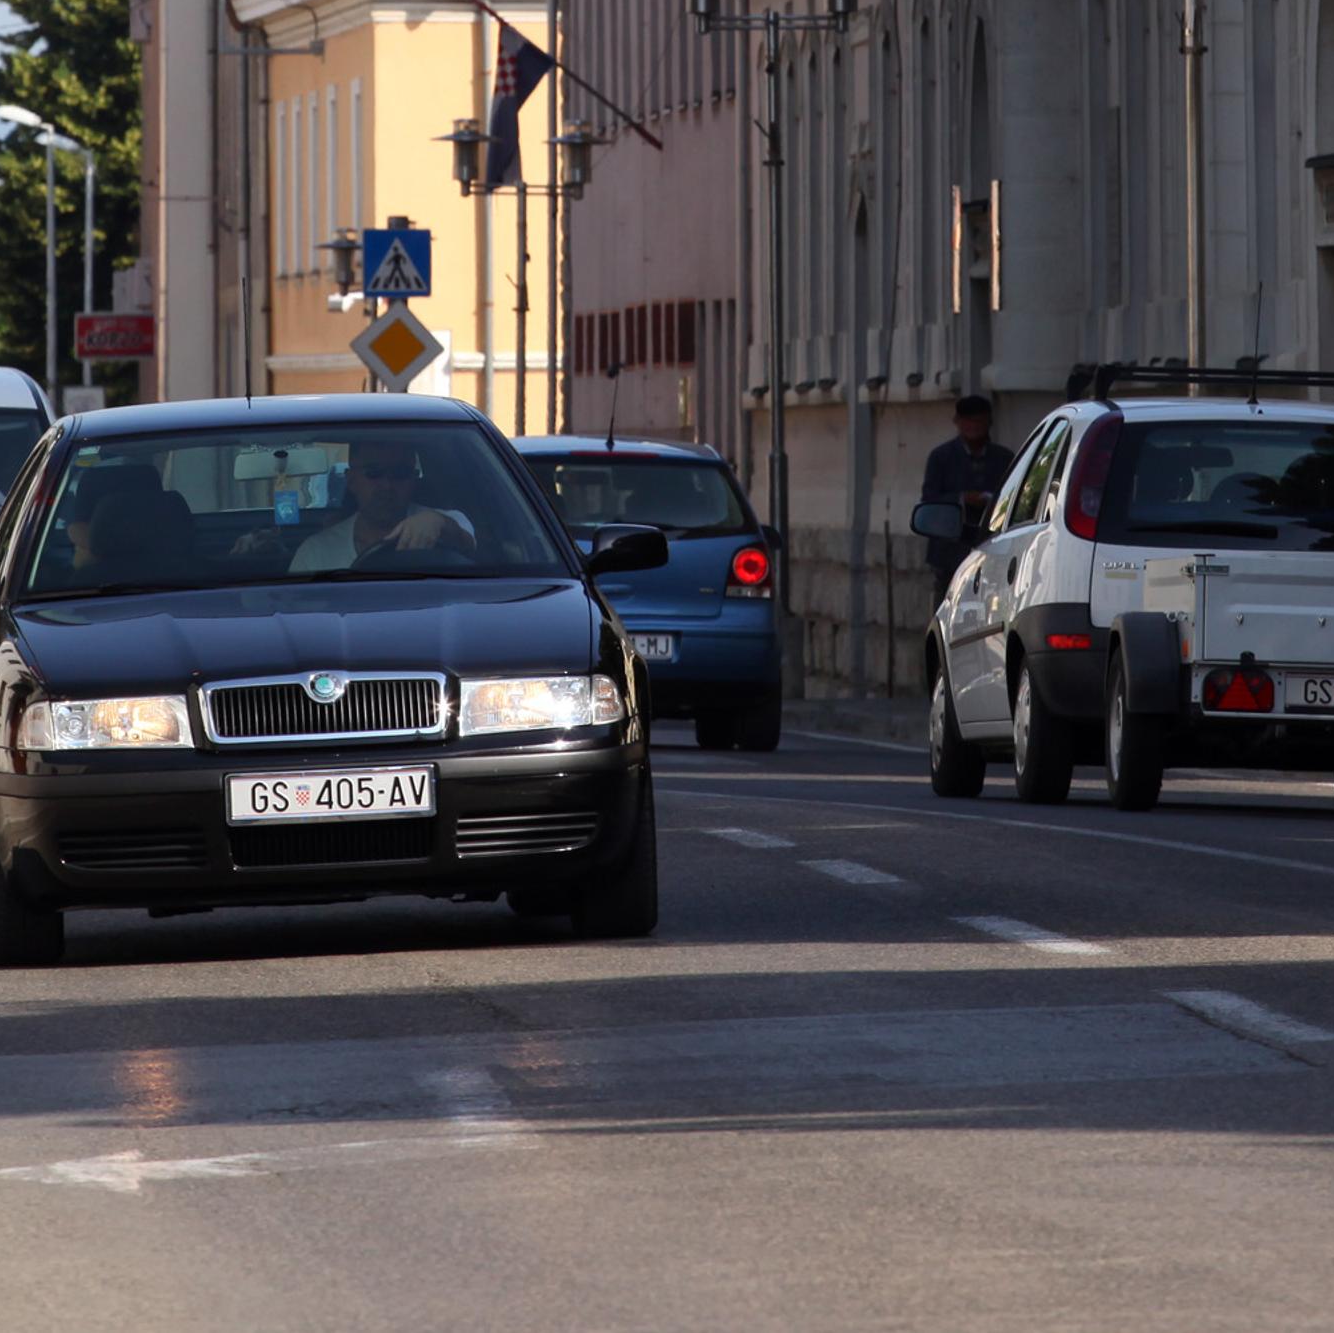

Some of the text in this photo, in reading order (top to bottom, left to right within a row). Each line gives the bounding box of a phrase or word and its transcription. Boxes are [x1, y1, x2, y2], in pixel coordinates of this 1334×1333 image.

[1303, 678, 1333, 705] GS
[251, 774, 427, 813] GS 405-AV
